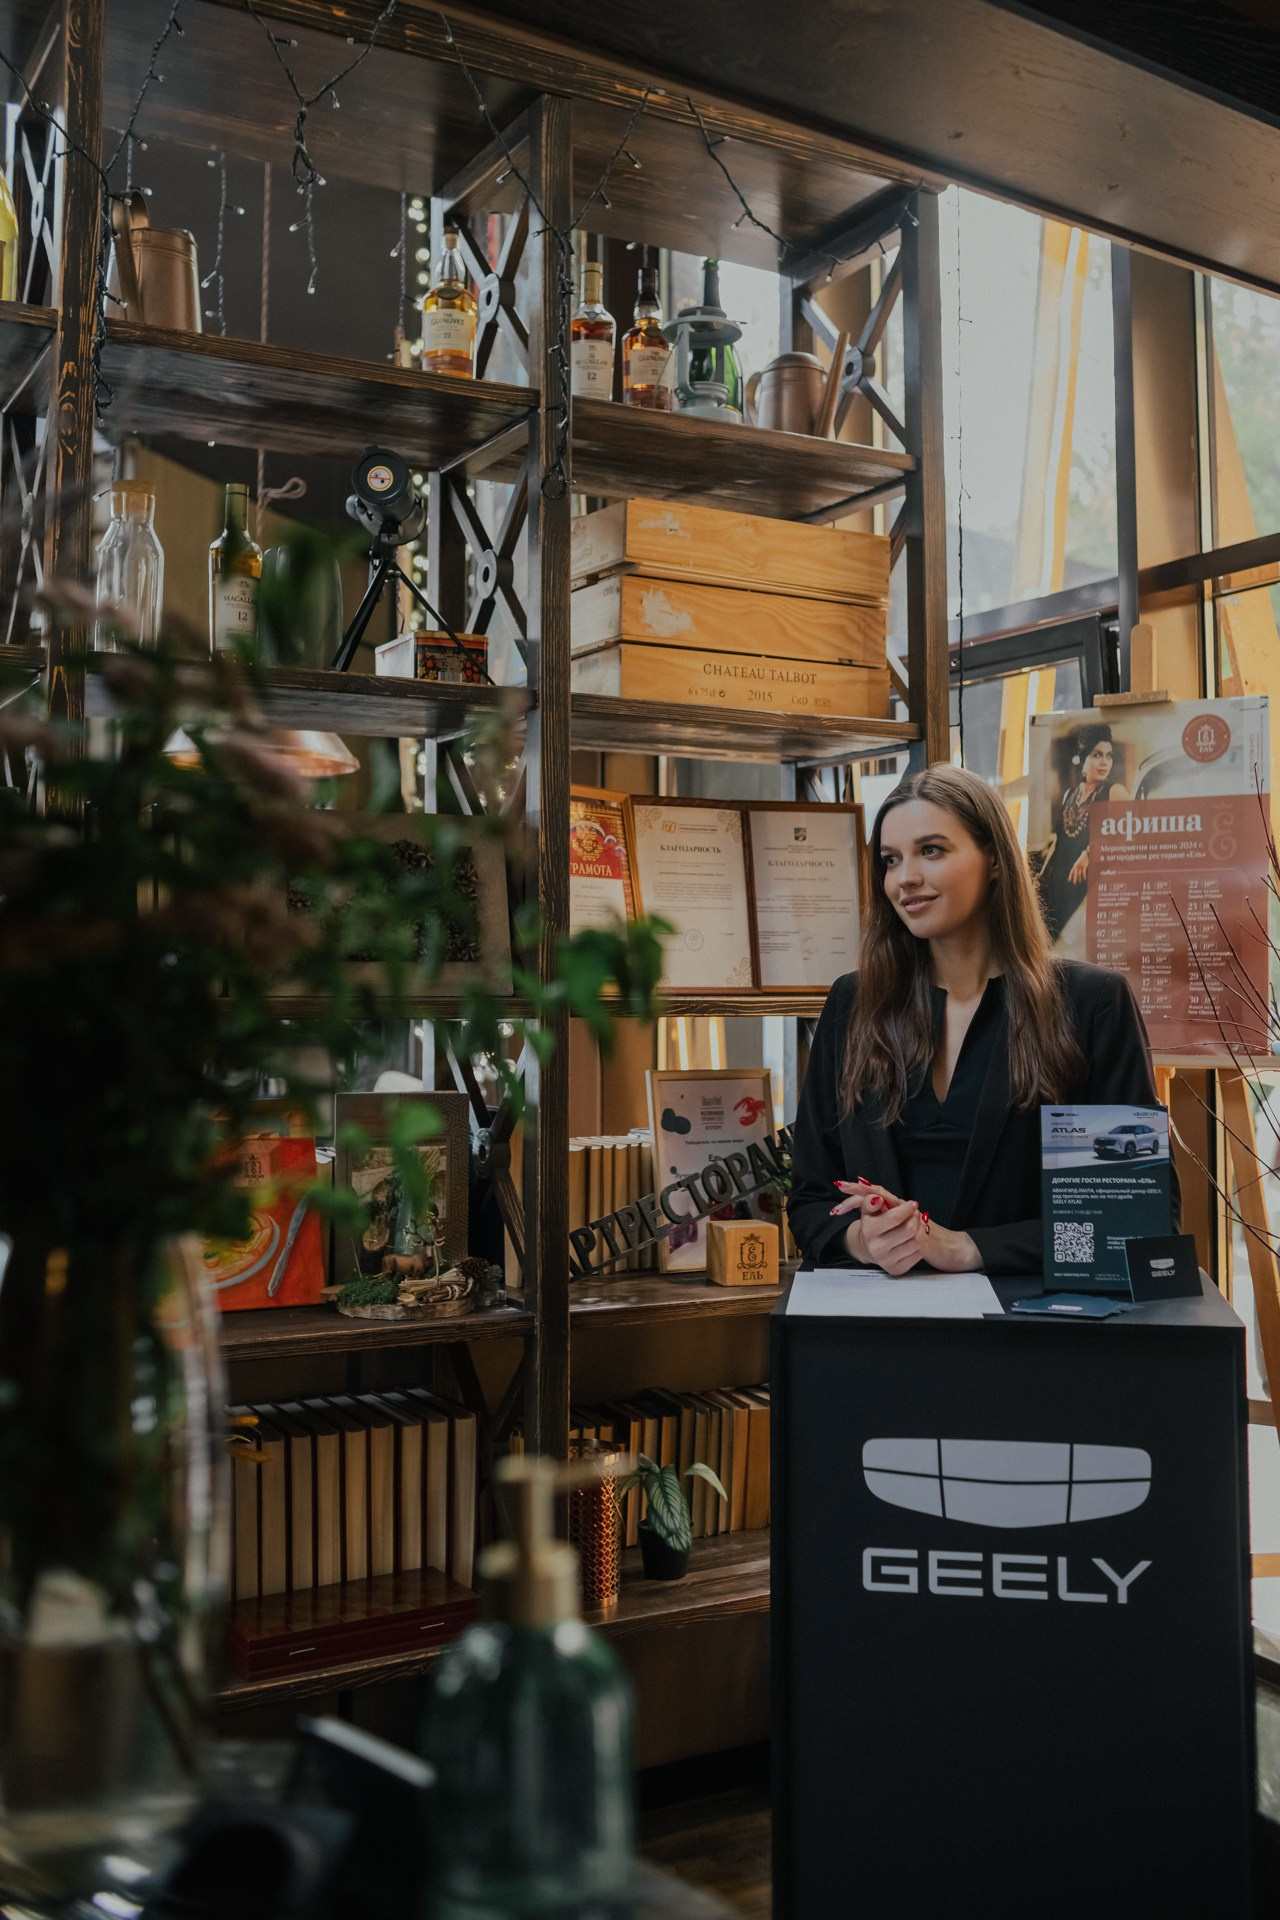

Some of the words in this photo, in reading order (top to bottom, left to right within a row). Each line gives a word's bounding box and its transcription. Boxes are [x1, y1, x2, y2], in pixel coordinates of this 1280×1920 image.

[587, 372, 597, 380] 12
[224, 595, 258, 605] MACALLA
[238, 611, 248, 621] 12
[703, 663, 765, 680] CHATEAU
[769, 670, 817, 685] TALBOT
[747, 690, 773, 702] 2015
[1100, 810, 1203, 842] афиша
[660, 845, 721, 853] БЛАГОДАРНОСТЬ
[1100, 844, 1148, 853] Мероприятия
[1105, 855, 1147, 863] загородном
[1148, 852, 1184, 861] ресторане
[1142, 978, 1150, 986] 17
[1141, 995, 1150, 1003] 21
[1189, 996, 1199, 1004] 30
[569, 1122, 795, 1284] РТРЕСТОРАН
[862, 1547, 1152, 1604] GEELY
